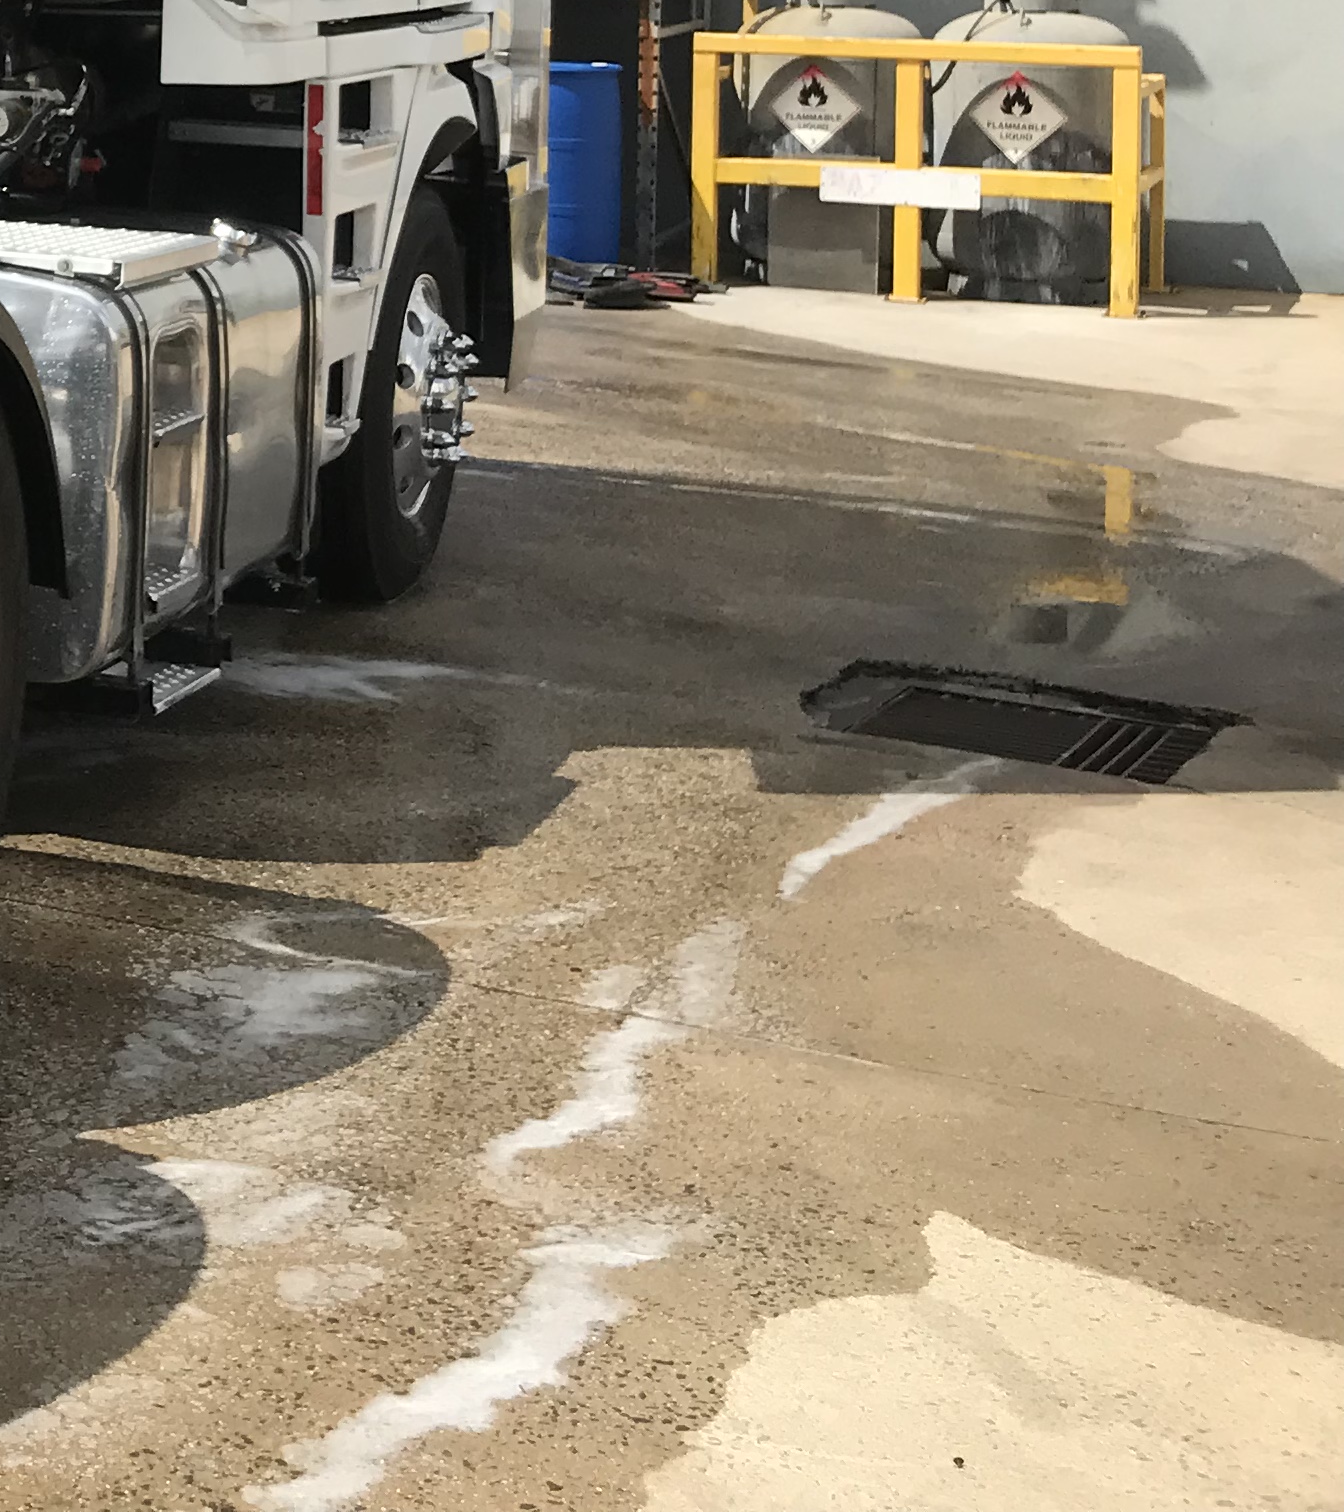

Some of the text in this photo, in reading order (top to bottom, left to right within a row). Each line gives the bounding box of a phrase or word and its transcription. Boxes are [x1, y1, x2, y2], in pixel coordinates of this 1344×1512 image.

[785, 112, 843, 123] FLAMMABLE
[986, 121, 1048, 133] FLAMMABLE
[999, 131, 1034, 142] LIQUID
